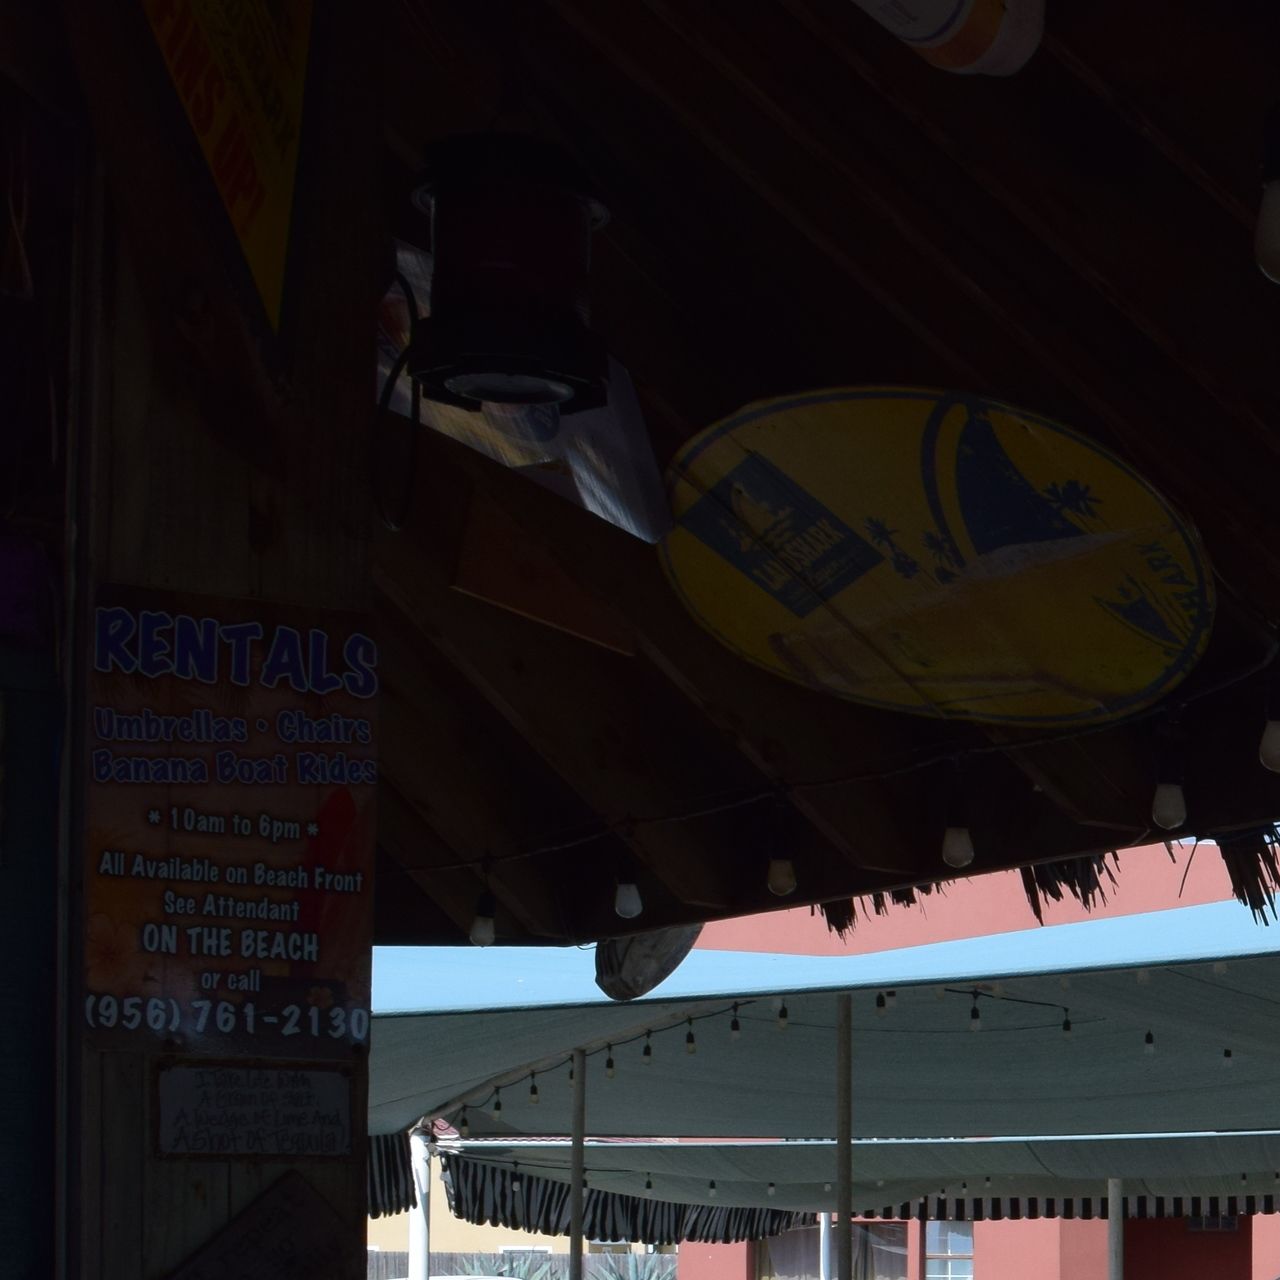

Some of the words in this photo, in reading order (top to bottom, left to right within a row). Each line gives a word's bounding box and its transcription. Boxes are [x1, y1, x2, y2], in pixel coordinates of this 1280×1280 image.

[95, 607, 379, 698] RENTALS
[95, 707, 248, 742] Umbrellas
[276, 710, 371, 743] Chairs
[93, 749, 208, 783] Banana
[216, 751, 288, 784] Boat
[296, 752, 377, 784] Rides
[170, 807, 225, 833] 10am
[233, 815, 251, 833] to
[259, 815, 300, 842] 6pm
[100, 851, 125, 875] All
[132, 855, 219, 882] Available
[226, 866, 247, 884] on
[254, 864, 308, 888] Beach
[314, 868, 363, 892] Front
[164, 890, 196, 914] See
[203, 894, 300, 921] Attendant
[143, 924, 177, 953] ON
[187, 927, 231, 957] THE
[241, 929, 320, 961] BEACH
[201, 973, 220, 989] or
[227, 969, 261, 991] call
[85, 995, 180, 1032] (956)
[191, 999, 370, 1040] 761-2130
